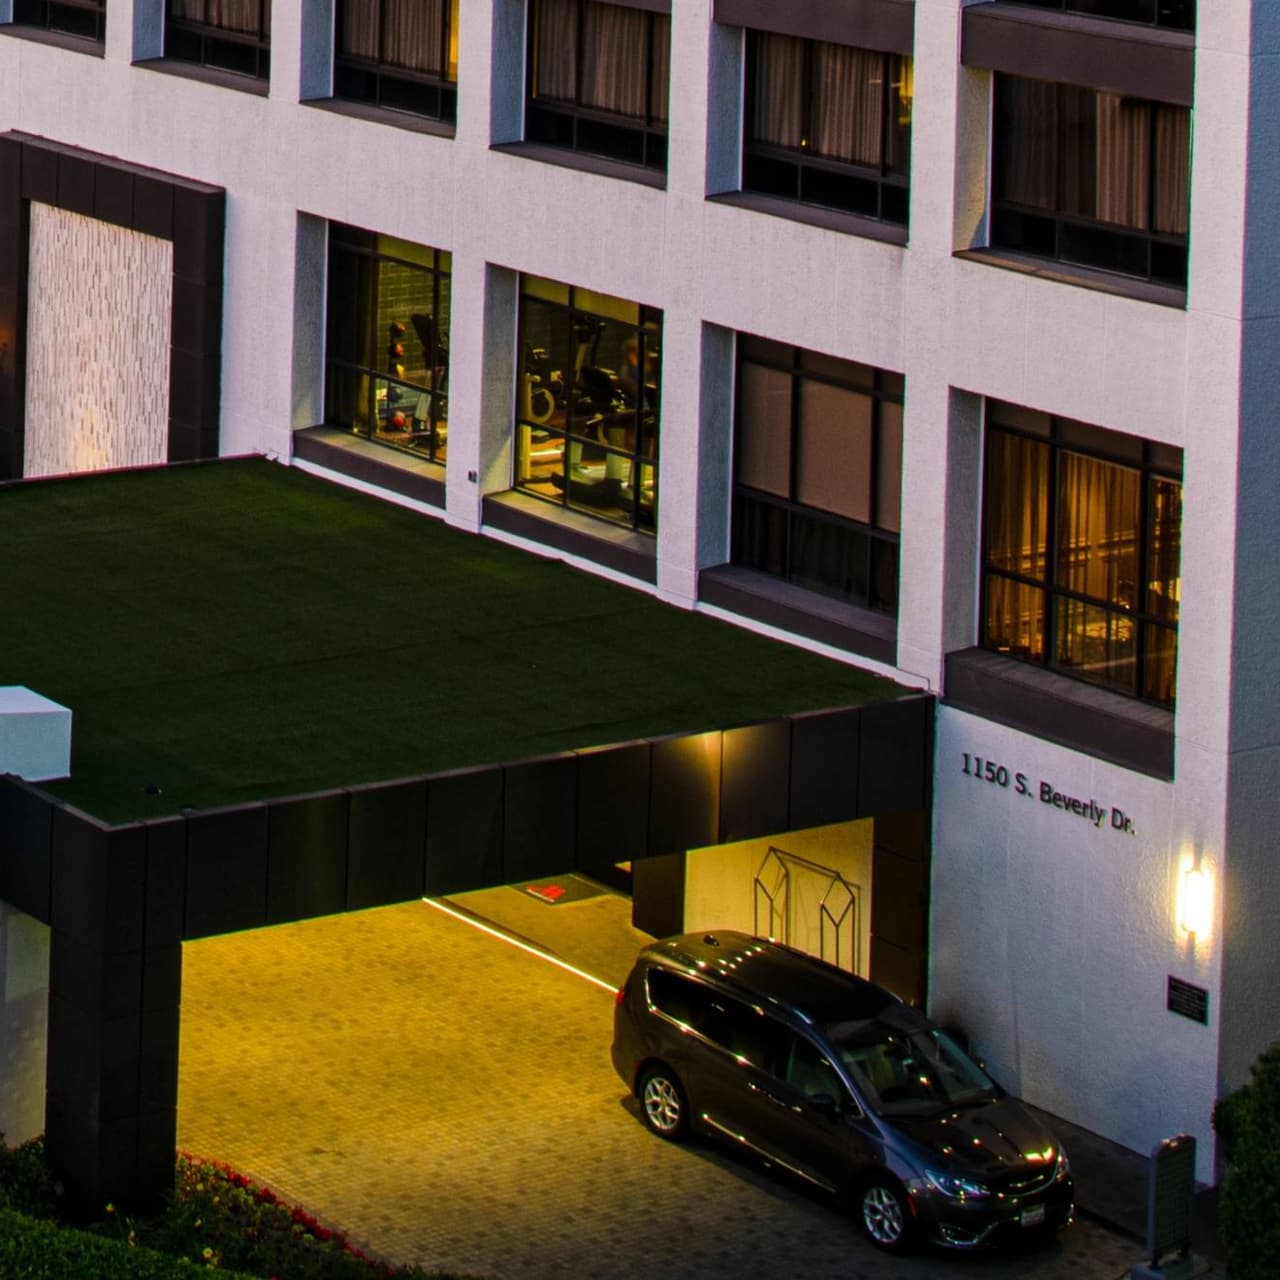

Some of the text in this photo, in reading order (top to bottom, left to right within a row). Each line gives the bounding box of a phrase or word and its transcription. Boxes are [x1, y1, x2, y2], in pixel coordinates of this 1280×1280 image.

[962, 752, 1137, 835] 1150 S. Beverly Dr.
